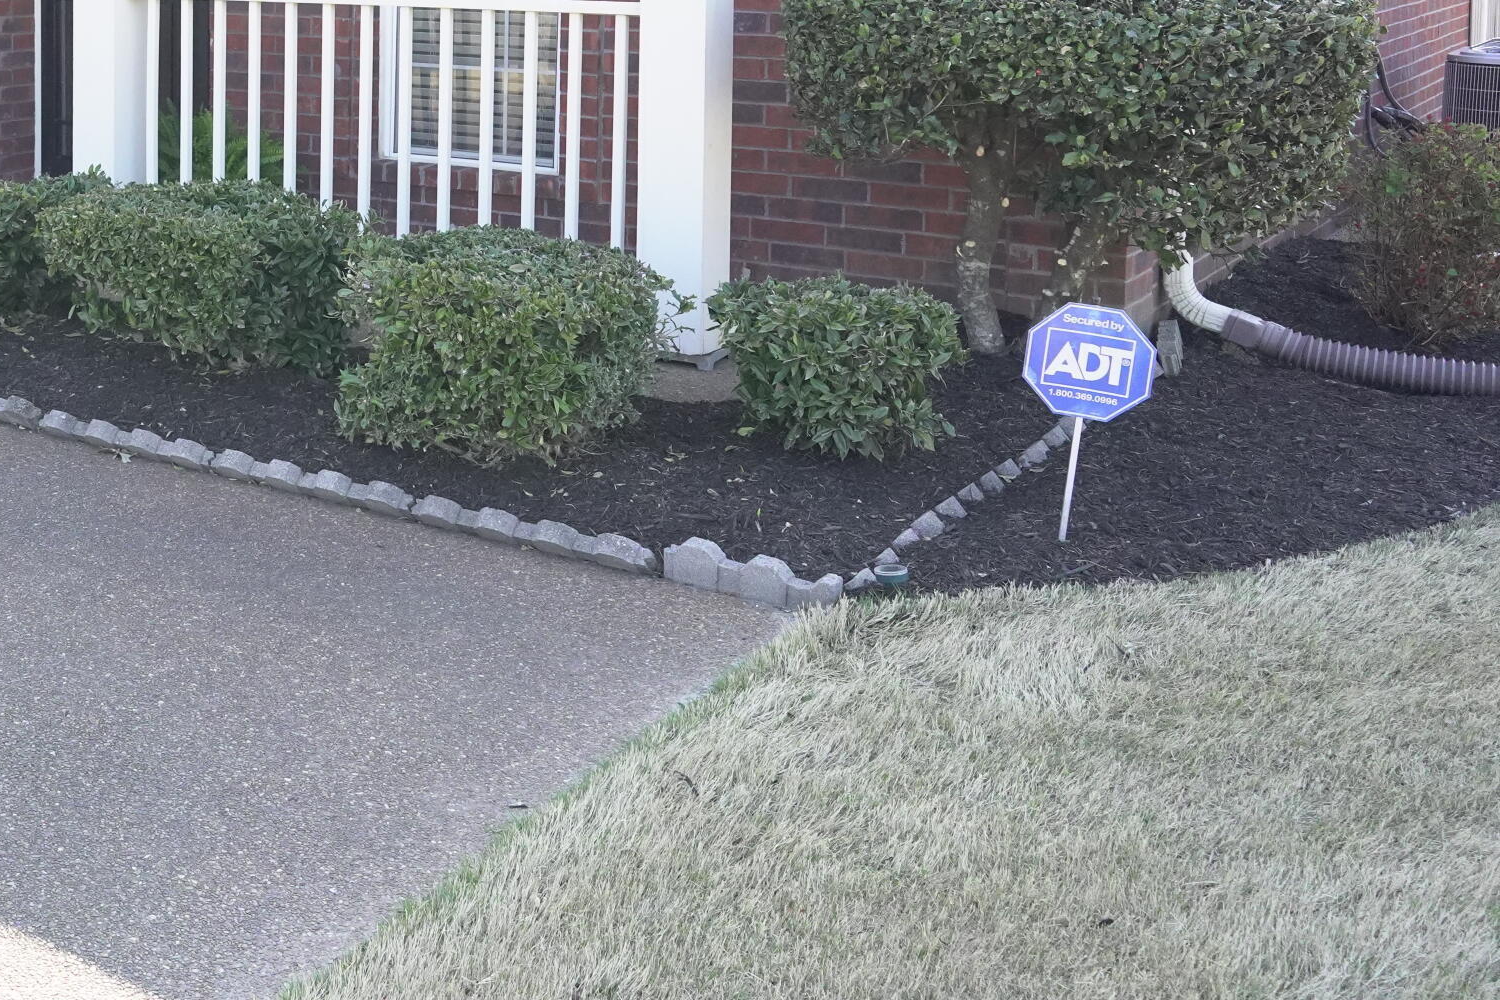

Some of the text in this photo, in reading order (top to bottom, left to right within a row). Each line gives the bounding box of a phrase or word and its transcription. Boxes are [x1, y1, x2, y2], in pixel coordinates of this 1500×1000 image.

[1063, 313, 1125, 332] Secured by
[1044, 341, 1133, 386] ADT
